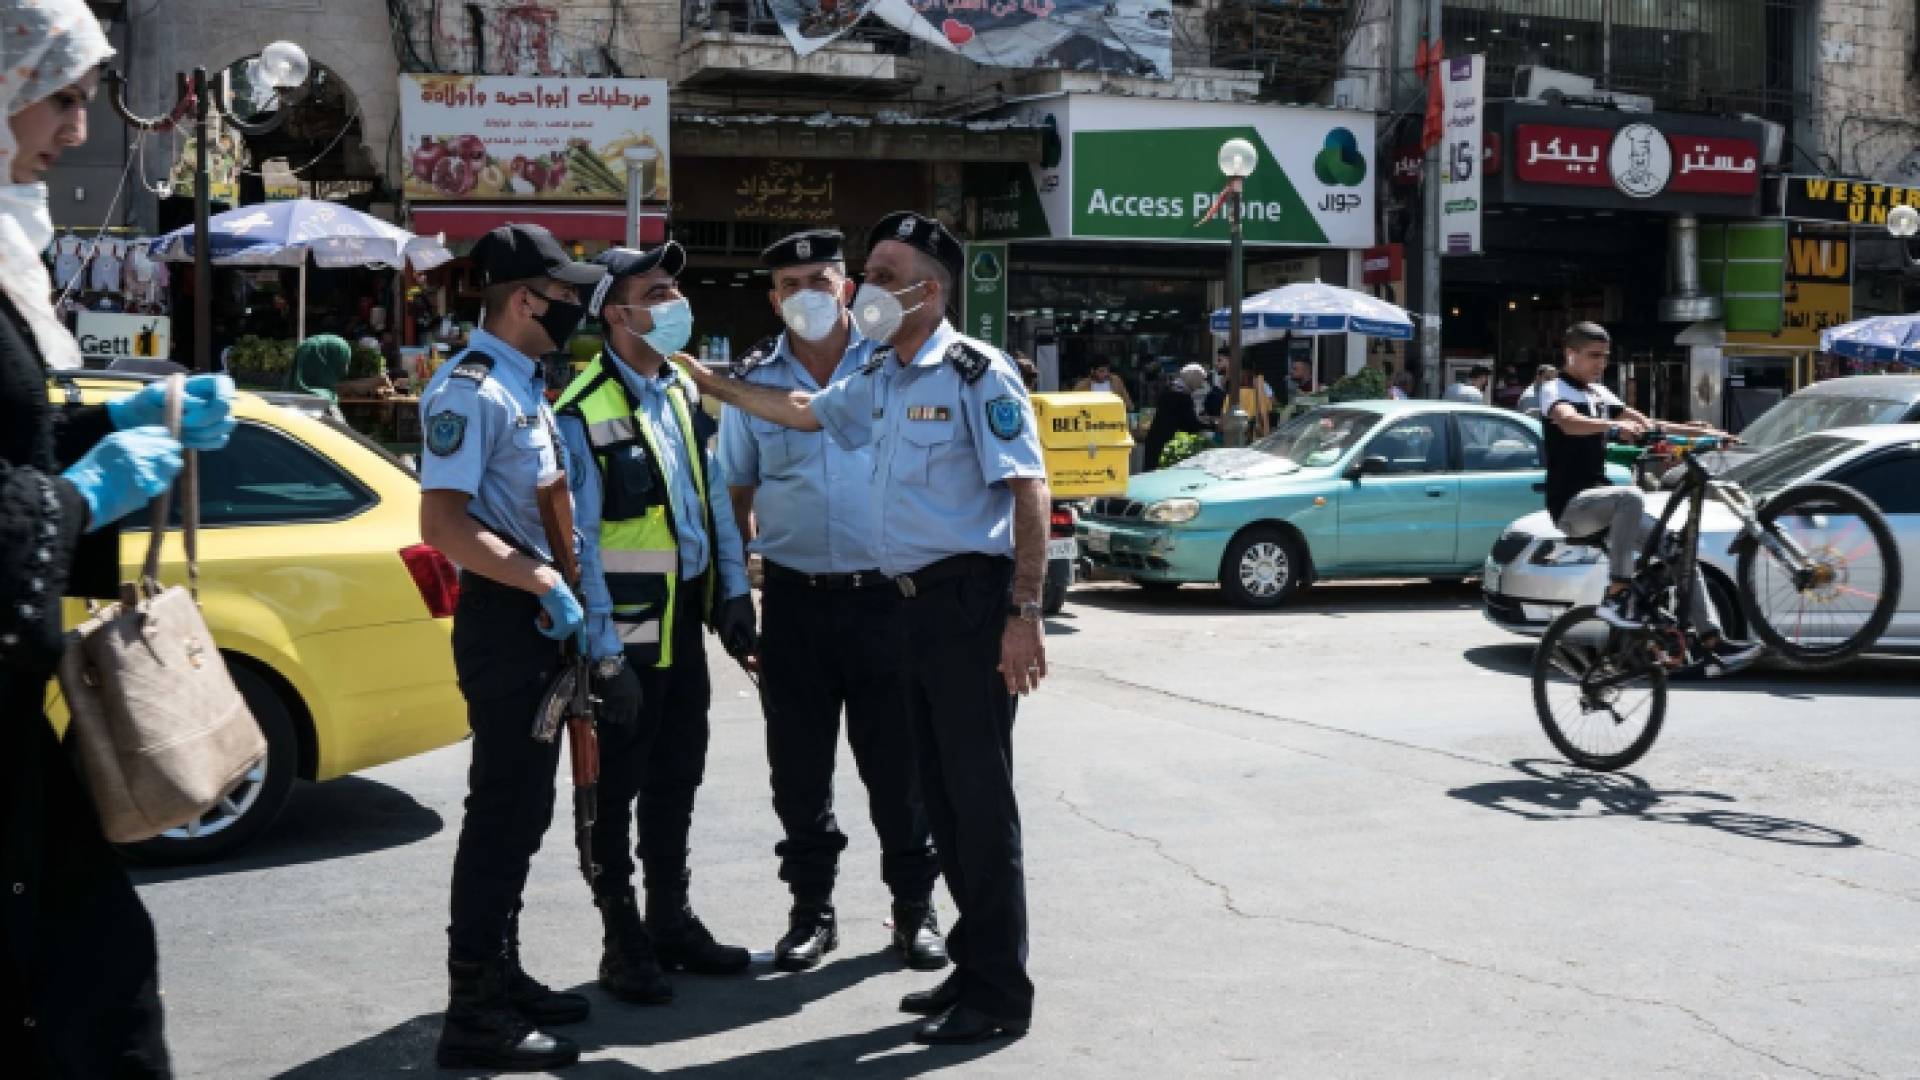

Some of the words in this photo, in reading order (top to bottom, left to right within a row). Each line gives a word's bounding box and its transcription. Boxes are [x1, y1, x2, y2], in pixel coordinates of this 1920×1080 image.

[577, 84, 652, 111] مرطبات
[1527, 136, 1600, 173] بيكر
[1680, 144, 1757, 175] مستر
[1087, 187, 1184, 218] Access
[1317, 192, 1363, 213] جوال
[982, 206, 1020, 232] Phone
[1791, 237, 1849, 279] WU
[79, 333, 130, 355] Gett
[1052, 417, 1082, 433] BEE
